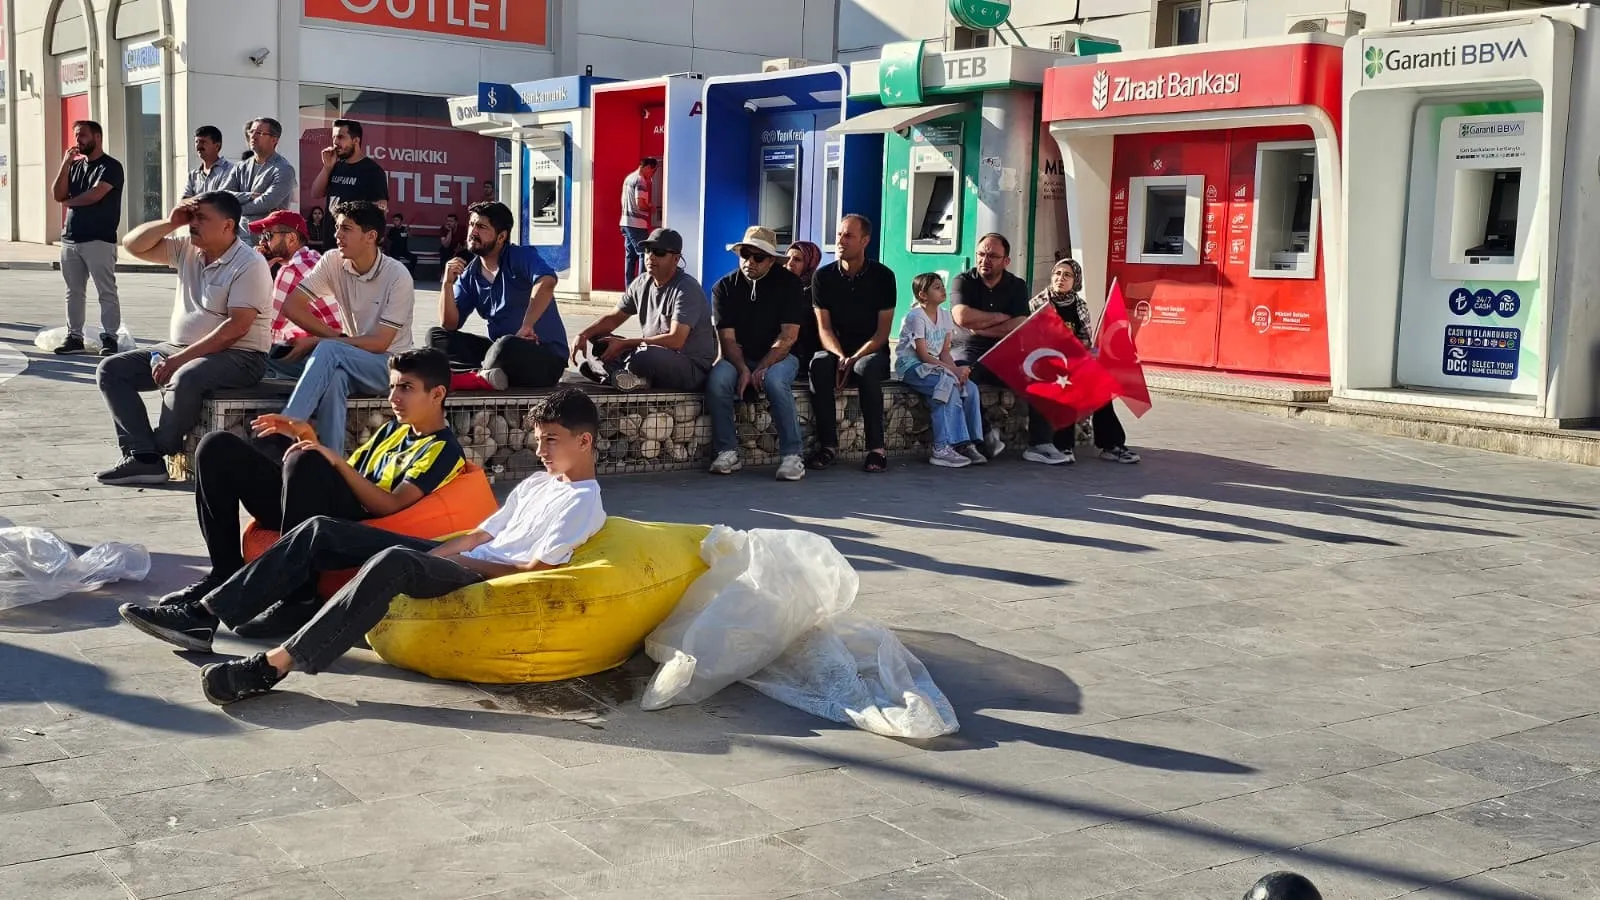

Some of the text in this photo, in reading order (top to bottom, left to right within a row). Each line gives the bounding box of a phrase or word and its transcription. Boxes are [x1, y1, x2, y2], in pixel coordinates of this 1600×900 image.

[1385, 37, 1528, 71] Garanti BBVA
[944, 56, 987, 80] TEB
[1112, 69, 1241, 102] Ziraat Bankası
[1469, 123, 1521, 135] Garanti BBVA
[366, 145, 386, 160] LC
[386, 171, 475, 205] TLET
[1474, 302, 1492, 310] CASH
[1500, 302, 1515, 311] DCC
[1447, 328, 1464, 337] CASH
[1465, 329, 1472, 337] IN
[1479, 330, 1517, 339] LANGUAGES
[1447, 359, 1467, 371] DCC
[1471, 361, 1514, 370] SELECT YOUR
